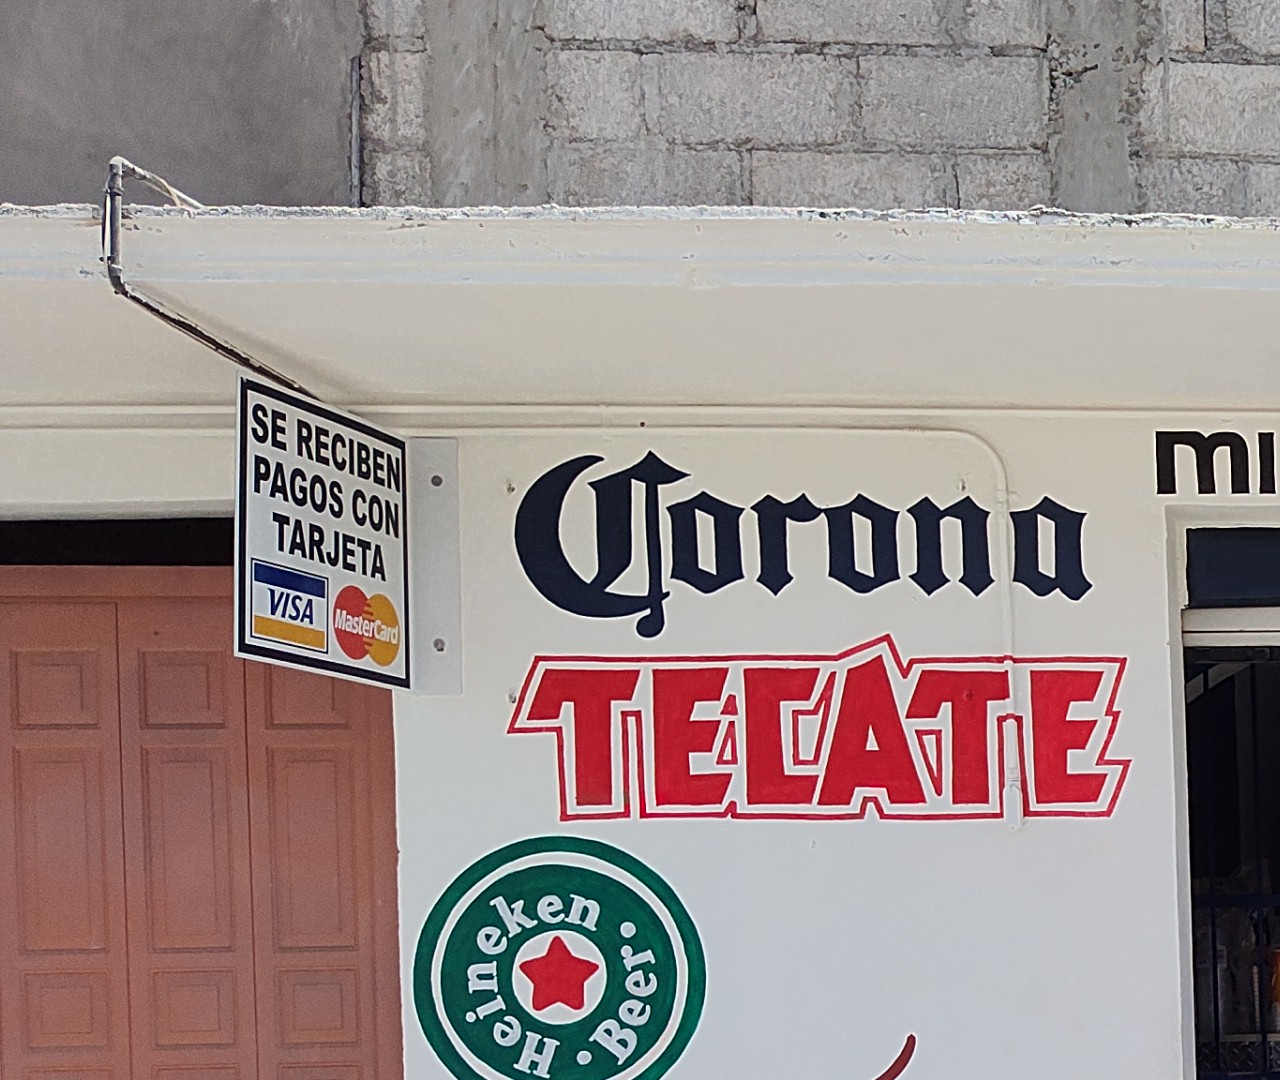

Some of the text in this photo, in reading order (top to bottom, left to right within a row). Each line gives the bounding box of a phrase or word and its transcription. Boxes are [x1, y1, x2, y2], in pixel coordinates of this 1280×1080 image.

[251, 403, 401, 493] SE RECIBEN
[254, 454, 400, 539] PAGOS CON
[272, 511, 387, 582] TARJETA
[514, 450, 1094, 638] Corona
[267, 587, 314, 626] VISA
[334, 608, 399, 646] MasterCard
[515, 645, 1122, 815] TECATE
[465, 891, 602, 1079] Heineken
